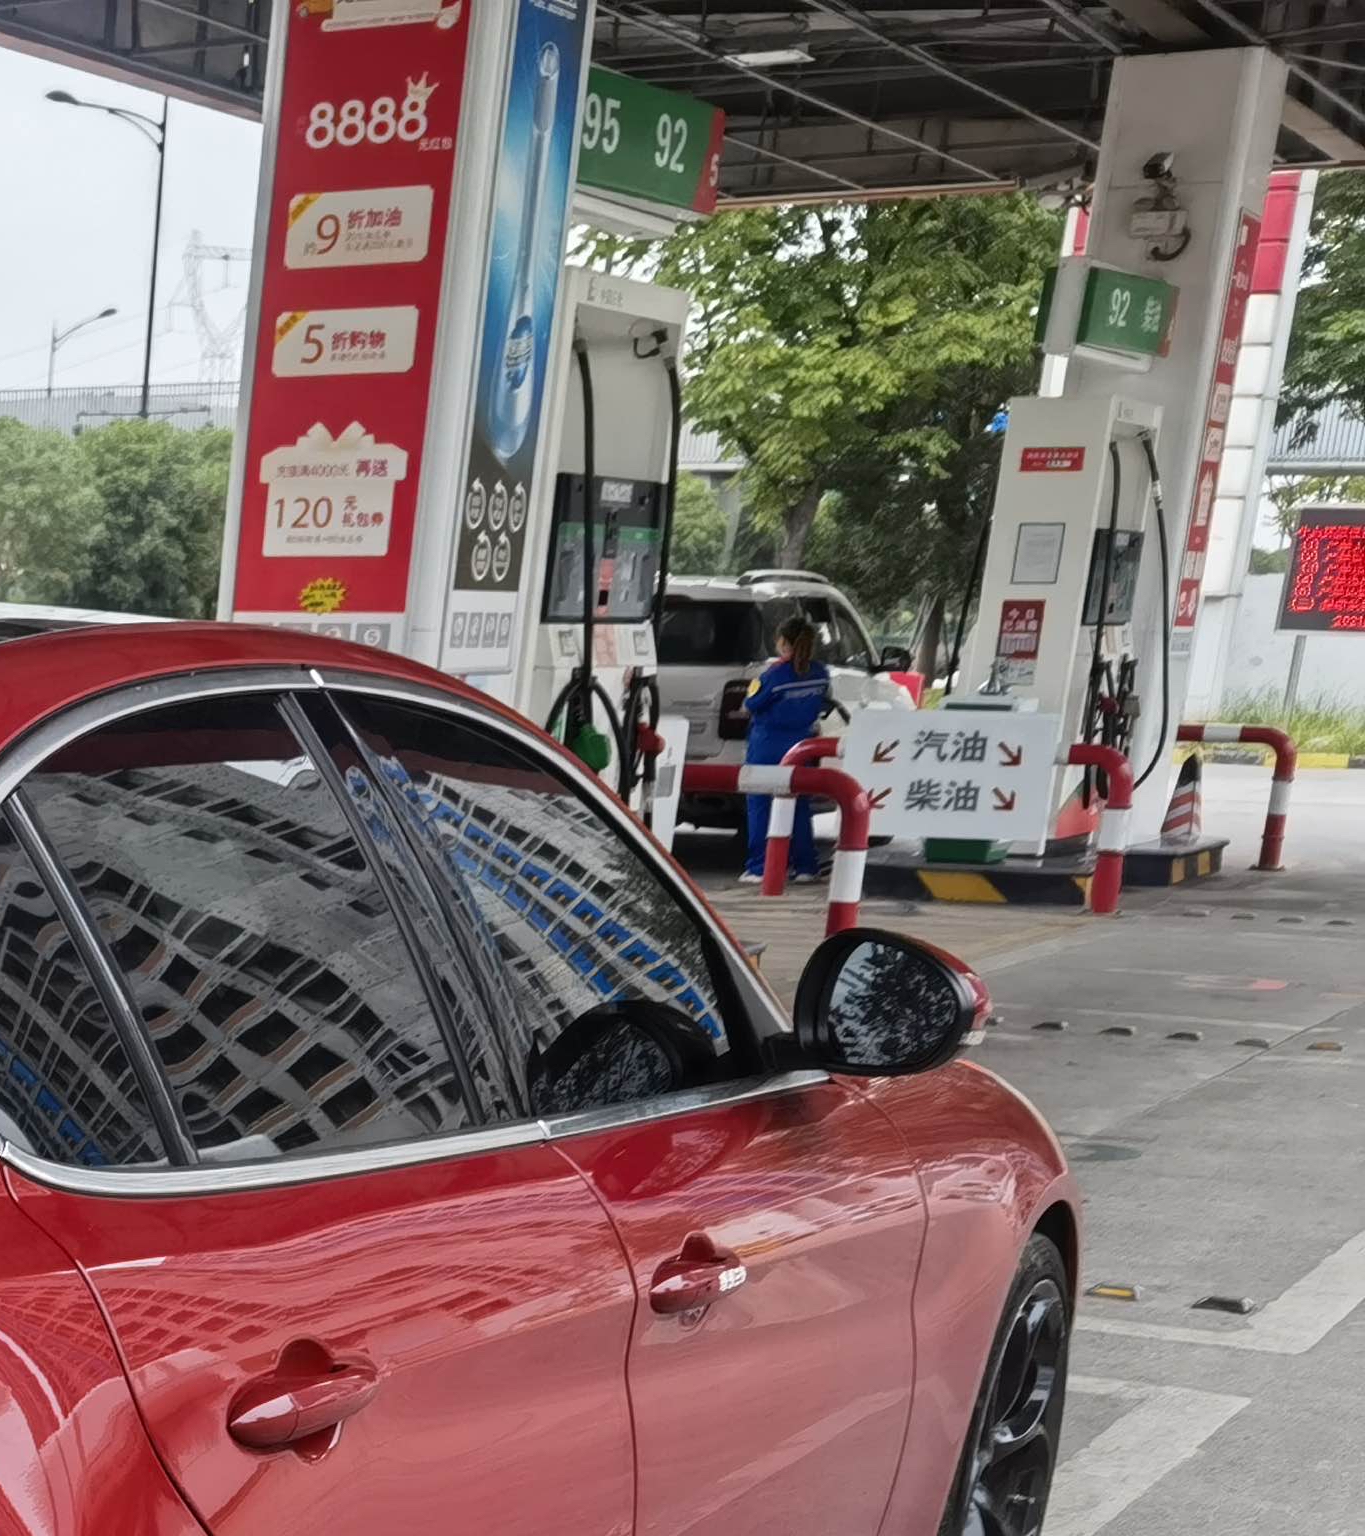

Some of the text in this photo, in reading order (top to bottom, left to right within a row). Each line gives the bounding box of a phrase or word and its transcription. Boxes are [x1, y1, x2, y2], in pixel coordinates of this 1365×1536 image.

[305, 96, 428, 149] 8888
[582, 92, 688, 173] 95 92
[316, 213, 341, 255] 9
[1108, 288, 1131, 327] 92
[300, 323, 325, 364] 5
[274, 496, 334, 529] 120
[911, 730, 989, 763] 汽油
[904, 778, 981, 812] 柴油
